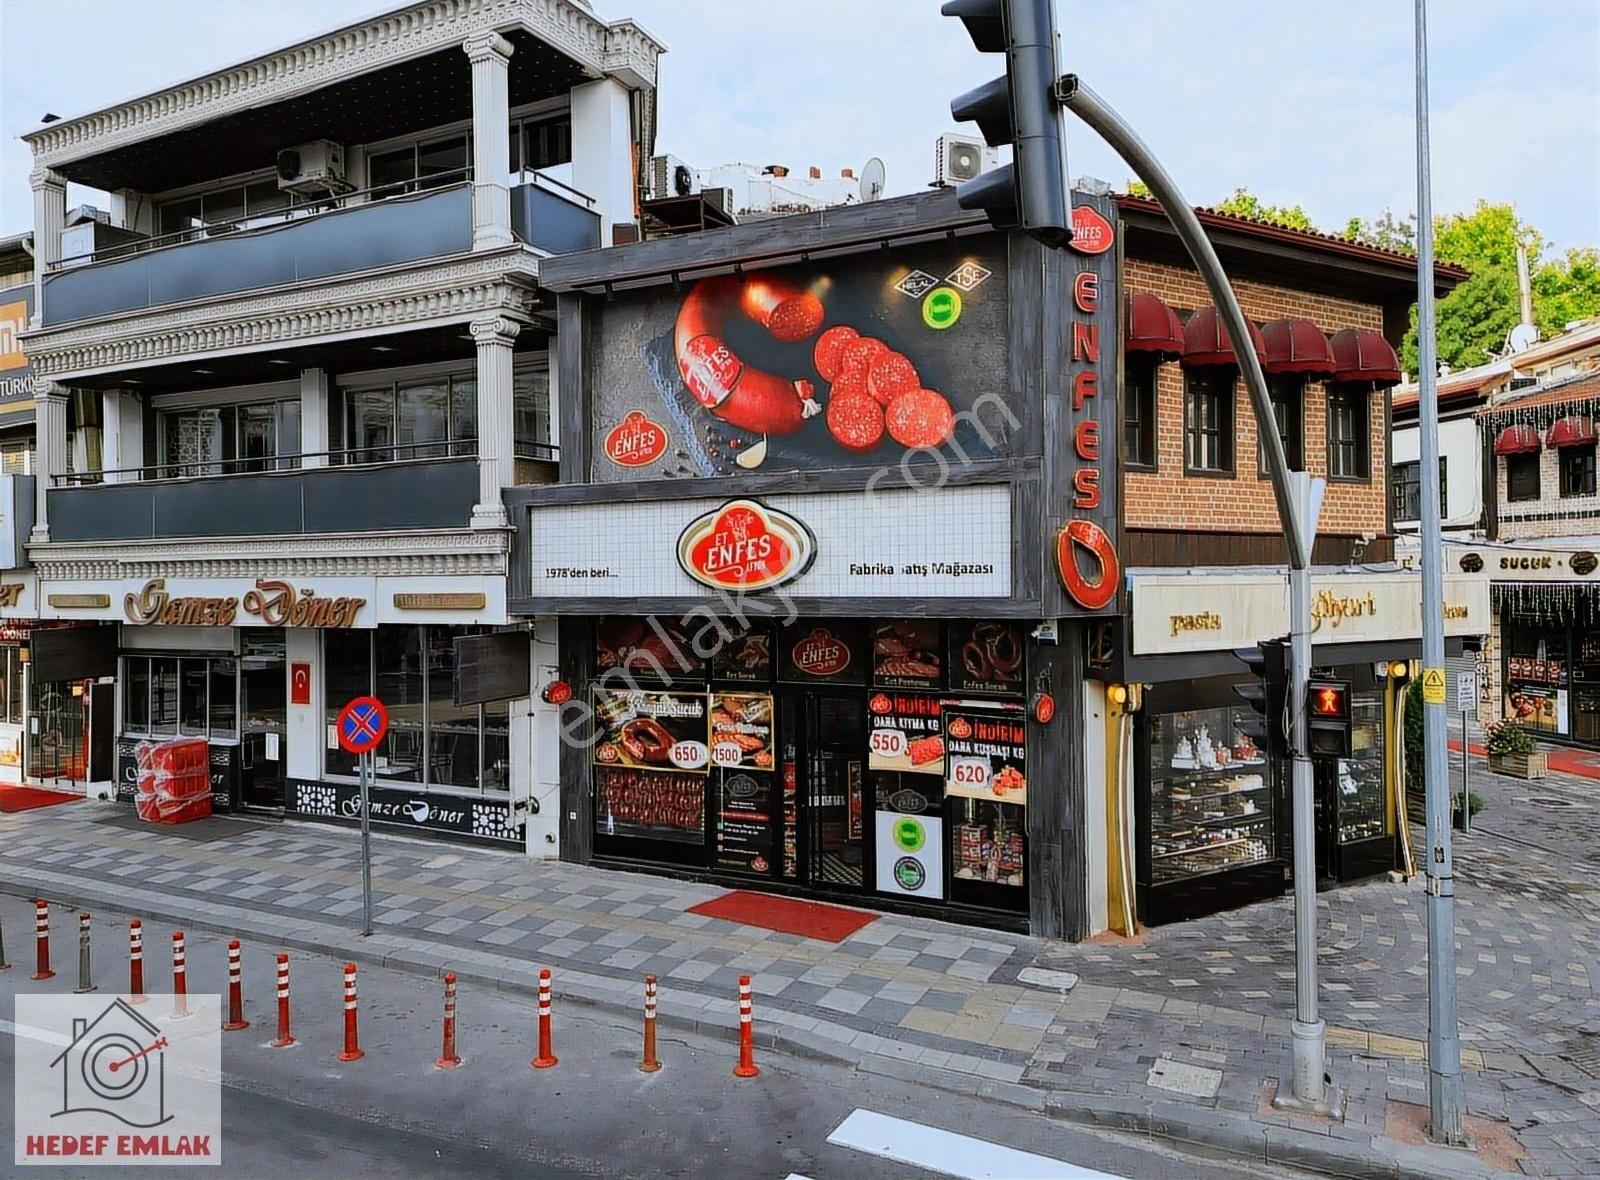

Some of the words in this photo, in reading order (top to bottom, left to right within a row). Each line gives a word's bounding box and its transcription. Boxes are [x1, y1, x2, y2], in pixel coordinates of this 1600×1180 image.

[1073, 272, 1101, 509] ENFES
[613, 430, 656, 458] ENFES
[715, 532, 729, 546] ET
[706, 534, 771, 571] ENFES
[849, 562, 894, 576] Fabrika
[931, 561, 994, 577] Mağazası
[123, 576, 239, 626] Gamze
[243, 578, 366, 628] Döner
[801, 646, 840, 665] ENFES
[873, 733, 900, 752] 550
[674, 746, 698, 761] 650
[714, 748, 738, 761] 1500
[1012, 747, 1025, 760] KG
[955, 764, 985, 783] 620
[342, 794, 399, 816] Gmze
